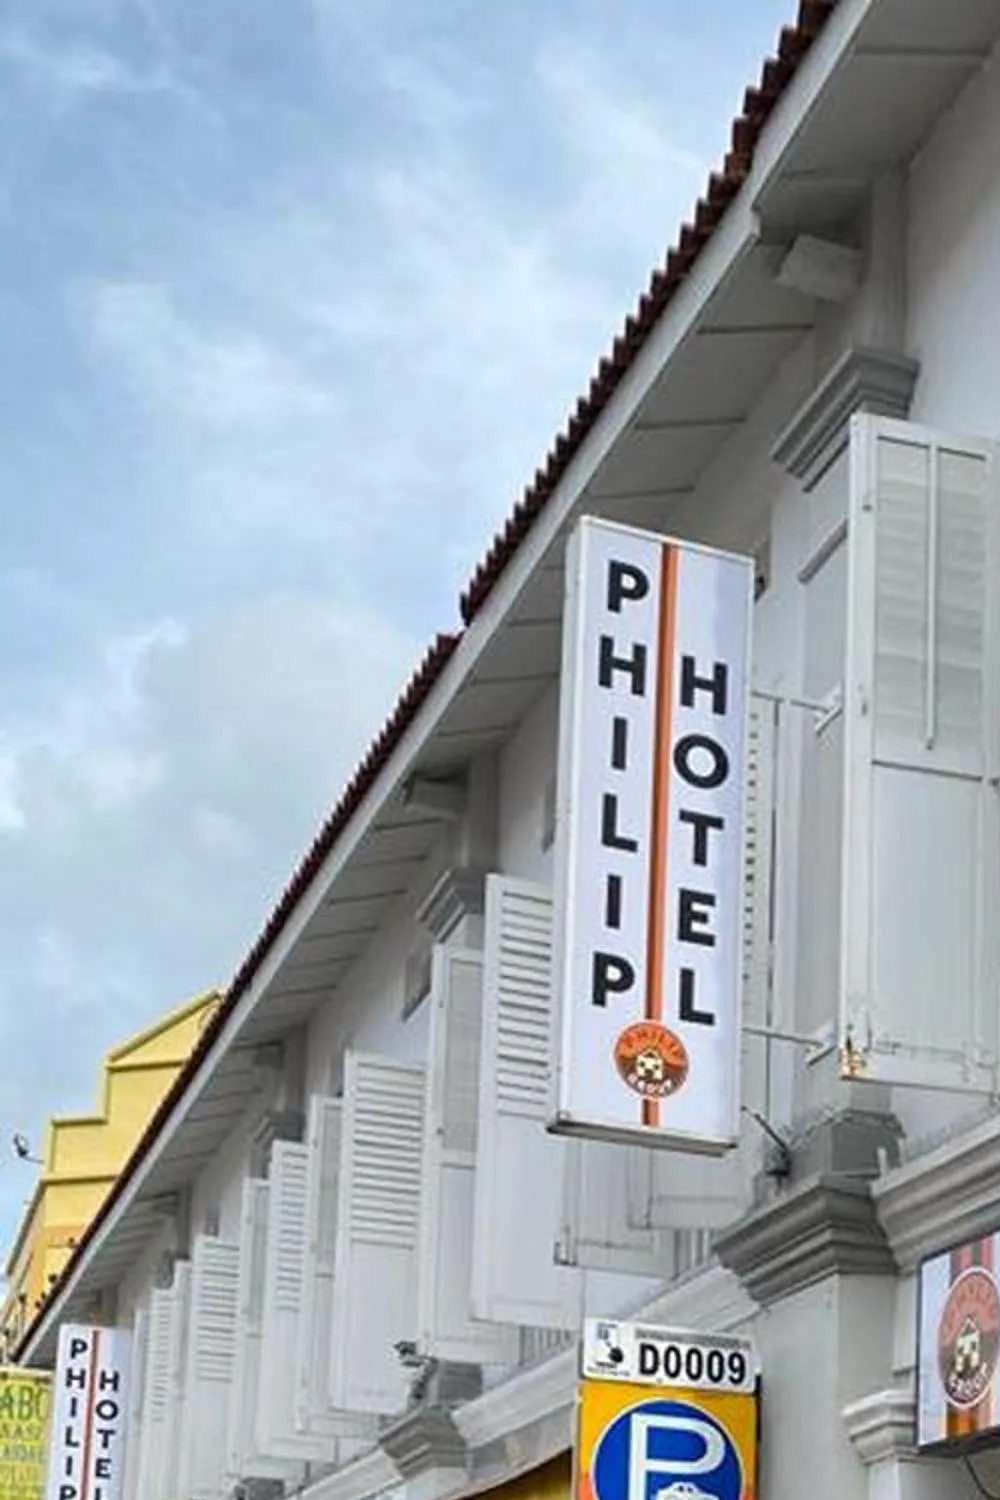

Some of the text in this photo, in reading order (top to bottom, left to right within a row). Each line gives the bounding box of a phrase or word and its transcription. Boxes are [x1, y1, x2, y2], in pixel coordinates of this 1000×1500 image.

[591, 560, 650, 1008] PHILIP
[673, 655, 729, 1027] HOTEL
[638, 1342, 747, 1385] D0009
